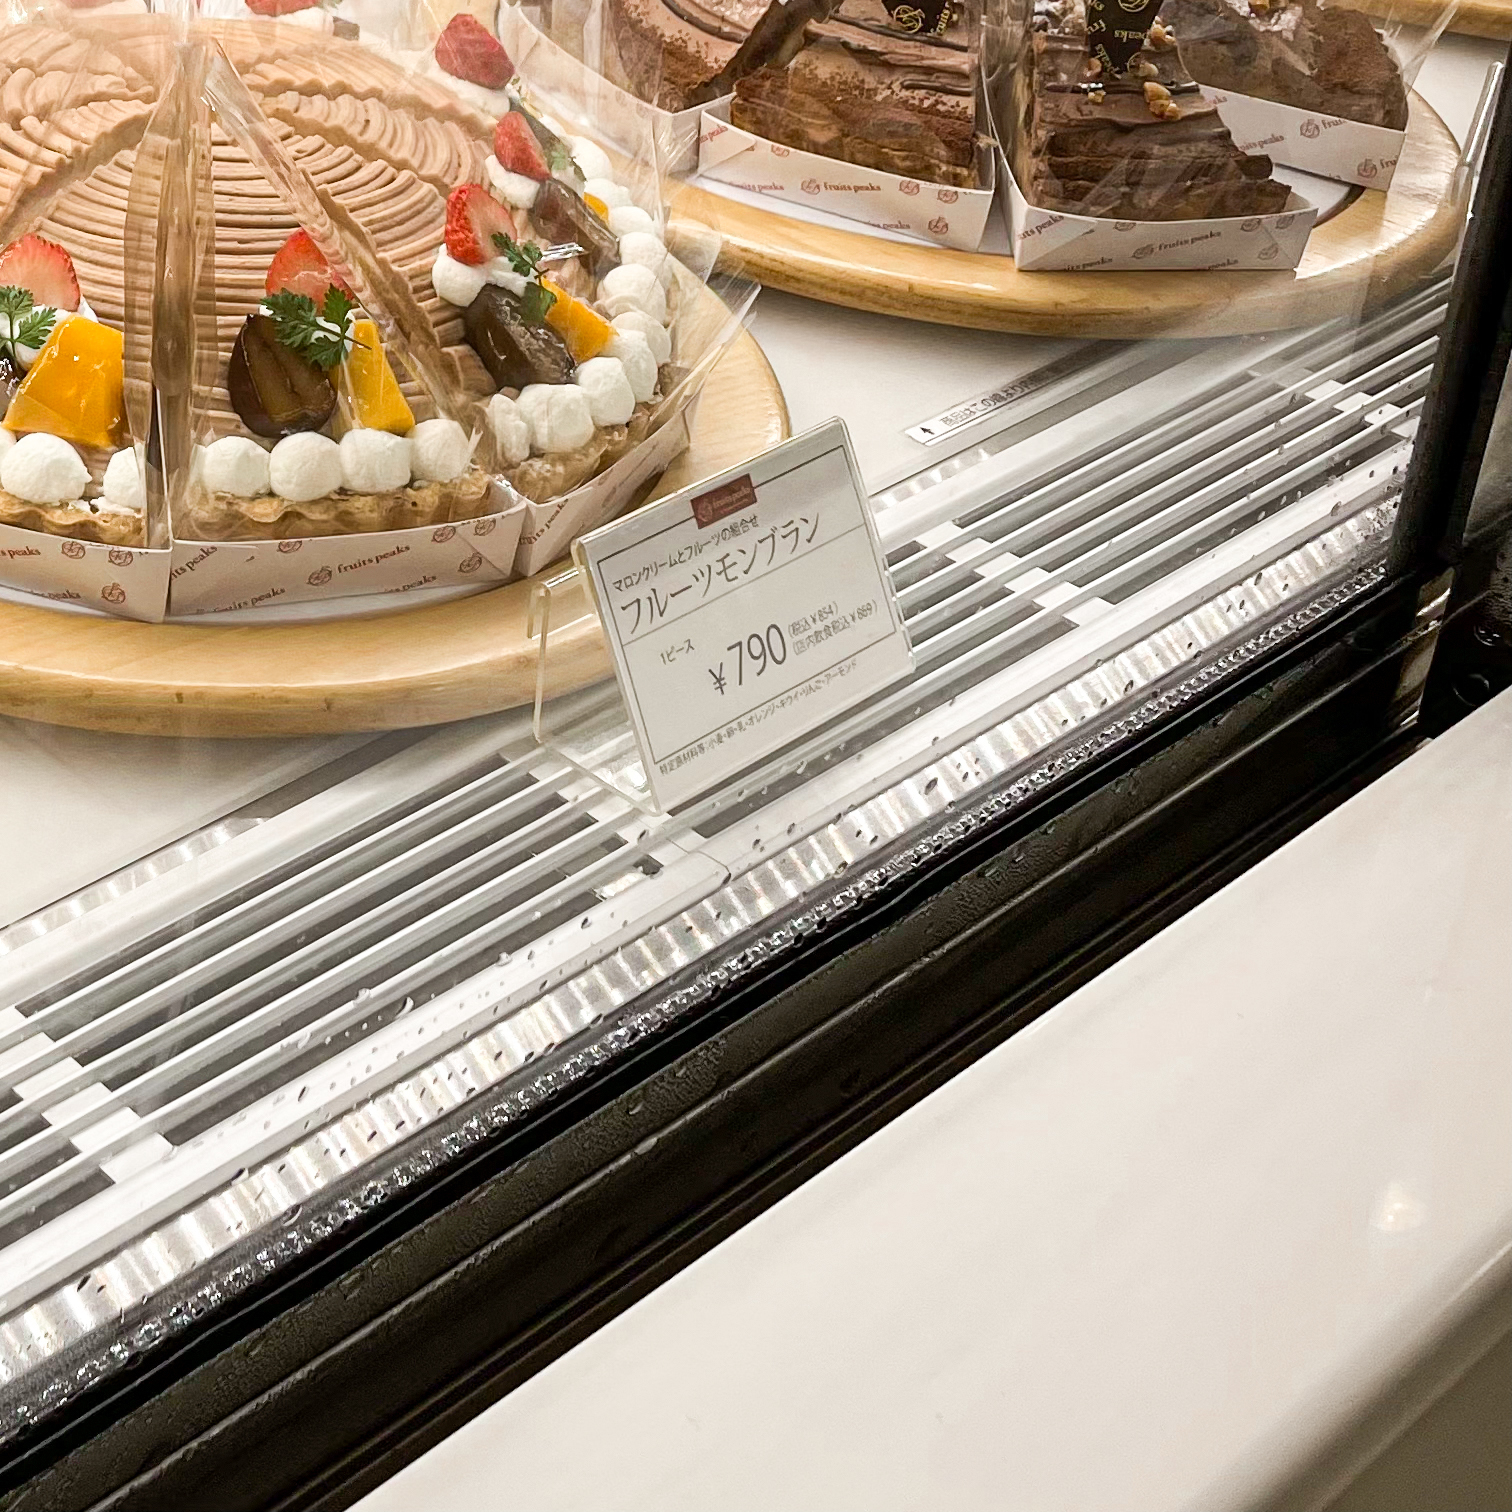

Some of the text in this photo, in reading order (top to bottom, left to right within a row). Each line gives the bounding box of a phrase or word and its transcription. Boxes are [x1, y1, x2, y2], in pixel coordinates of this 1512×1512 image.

[8, 546, 41, 560] peaks
[185, 545, 218, 571] peaks
[337, 544, 411, 575] fruits peaks
[620, 511, 820, 635] フルーツモンブラン
[250, 587, 286, 607] peaks
[707, 623, 787, 696] ¥790
